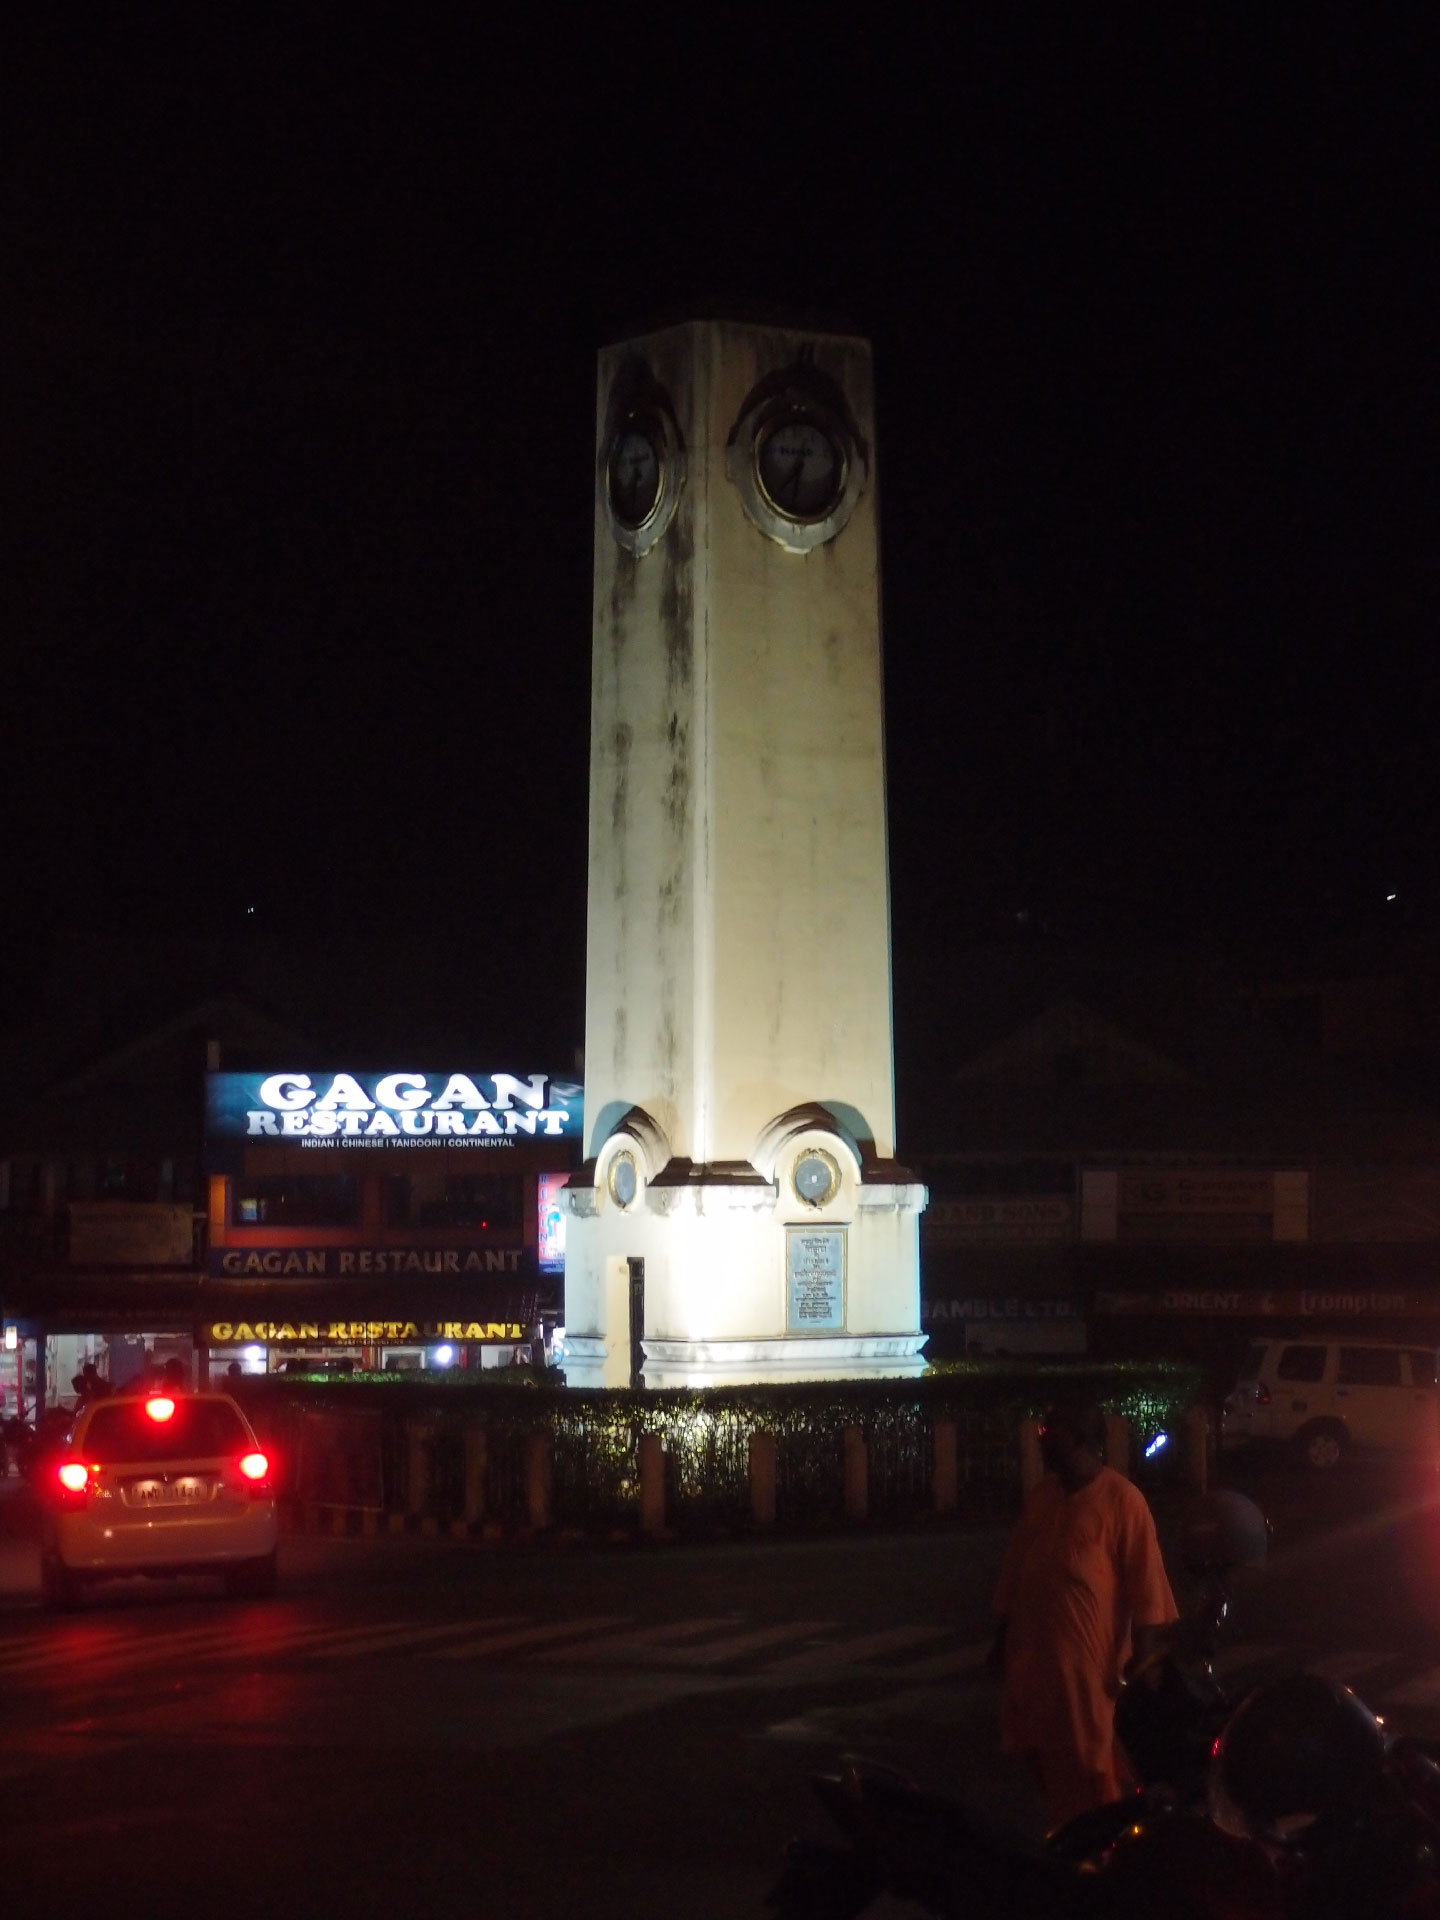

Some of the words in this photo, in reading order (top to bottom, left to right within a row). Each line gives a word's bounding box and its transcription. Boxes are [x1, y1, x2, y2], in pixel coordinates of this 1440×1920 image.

[260, 1073, 549, 1110] GAGAN
[246, 1110, 570, 1135] RESTAURANT
[301, 1138, 334, 1148] INDIAN
[342, 1138, 384, 1148] CHINESE
[391, 1138, 440, 1148] TANDOORI
[448, 1138, 515, 1148] CONTINENTAL
[222, 1251, 326, 1273] GAGAN
[339, 1250, 523, 1273] RESTAURANT
[212, 1321, 319, 1340] GAGAN
[327, 1321, 526, 1340] RESTAURANT
